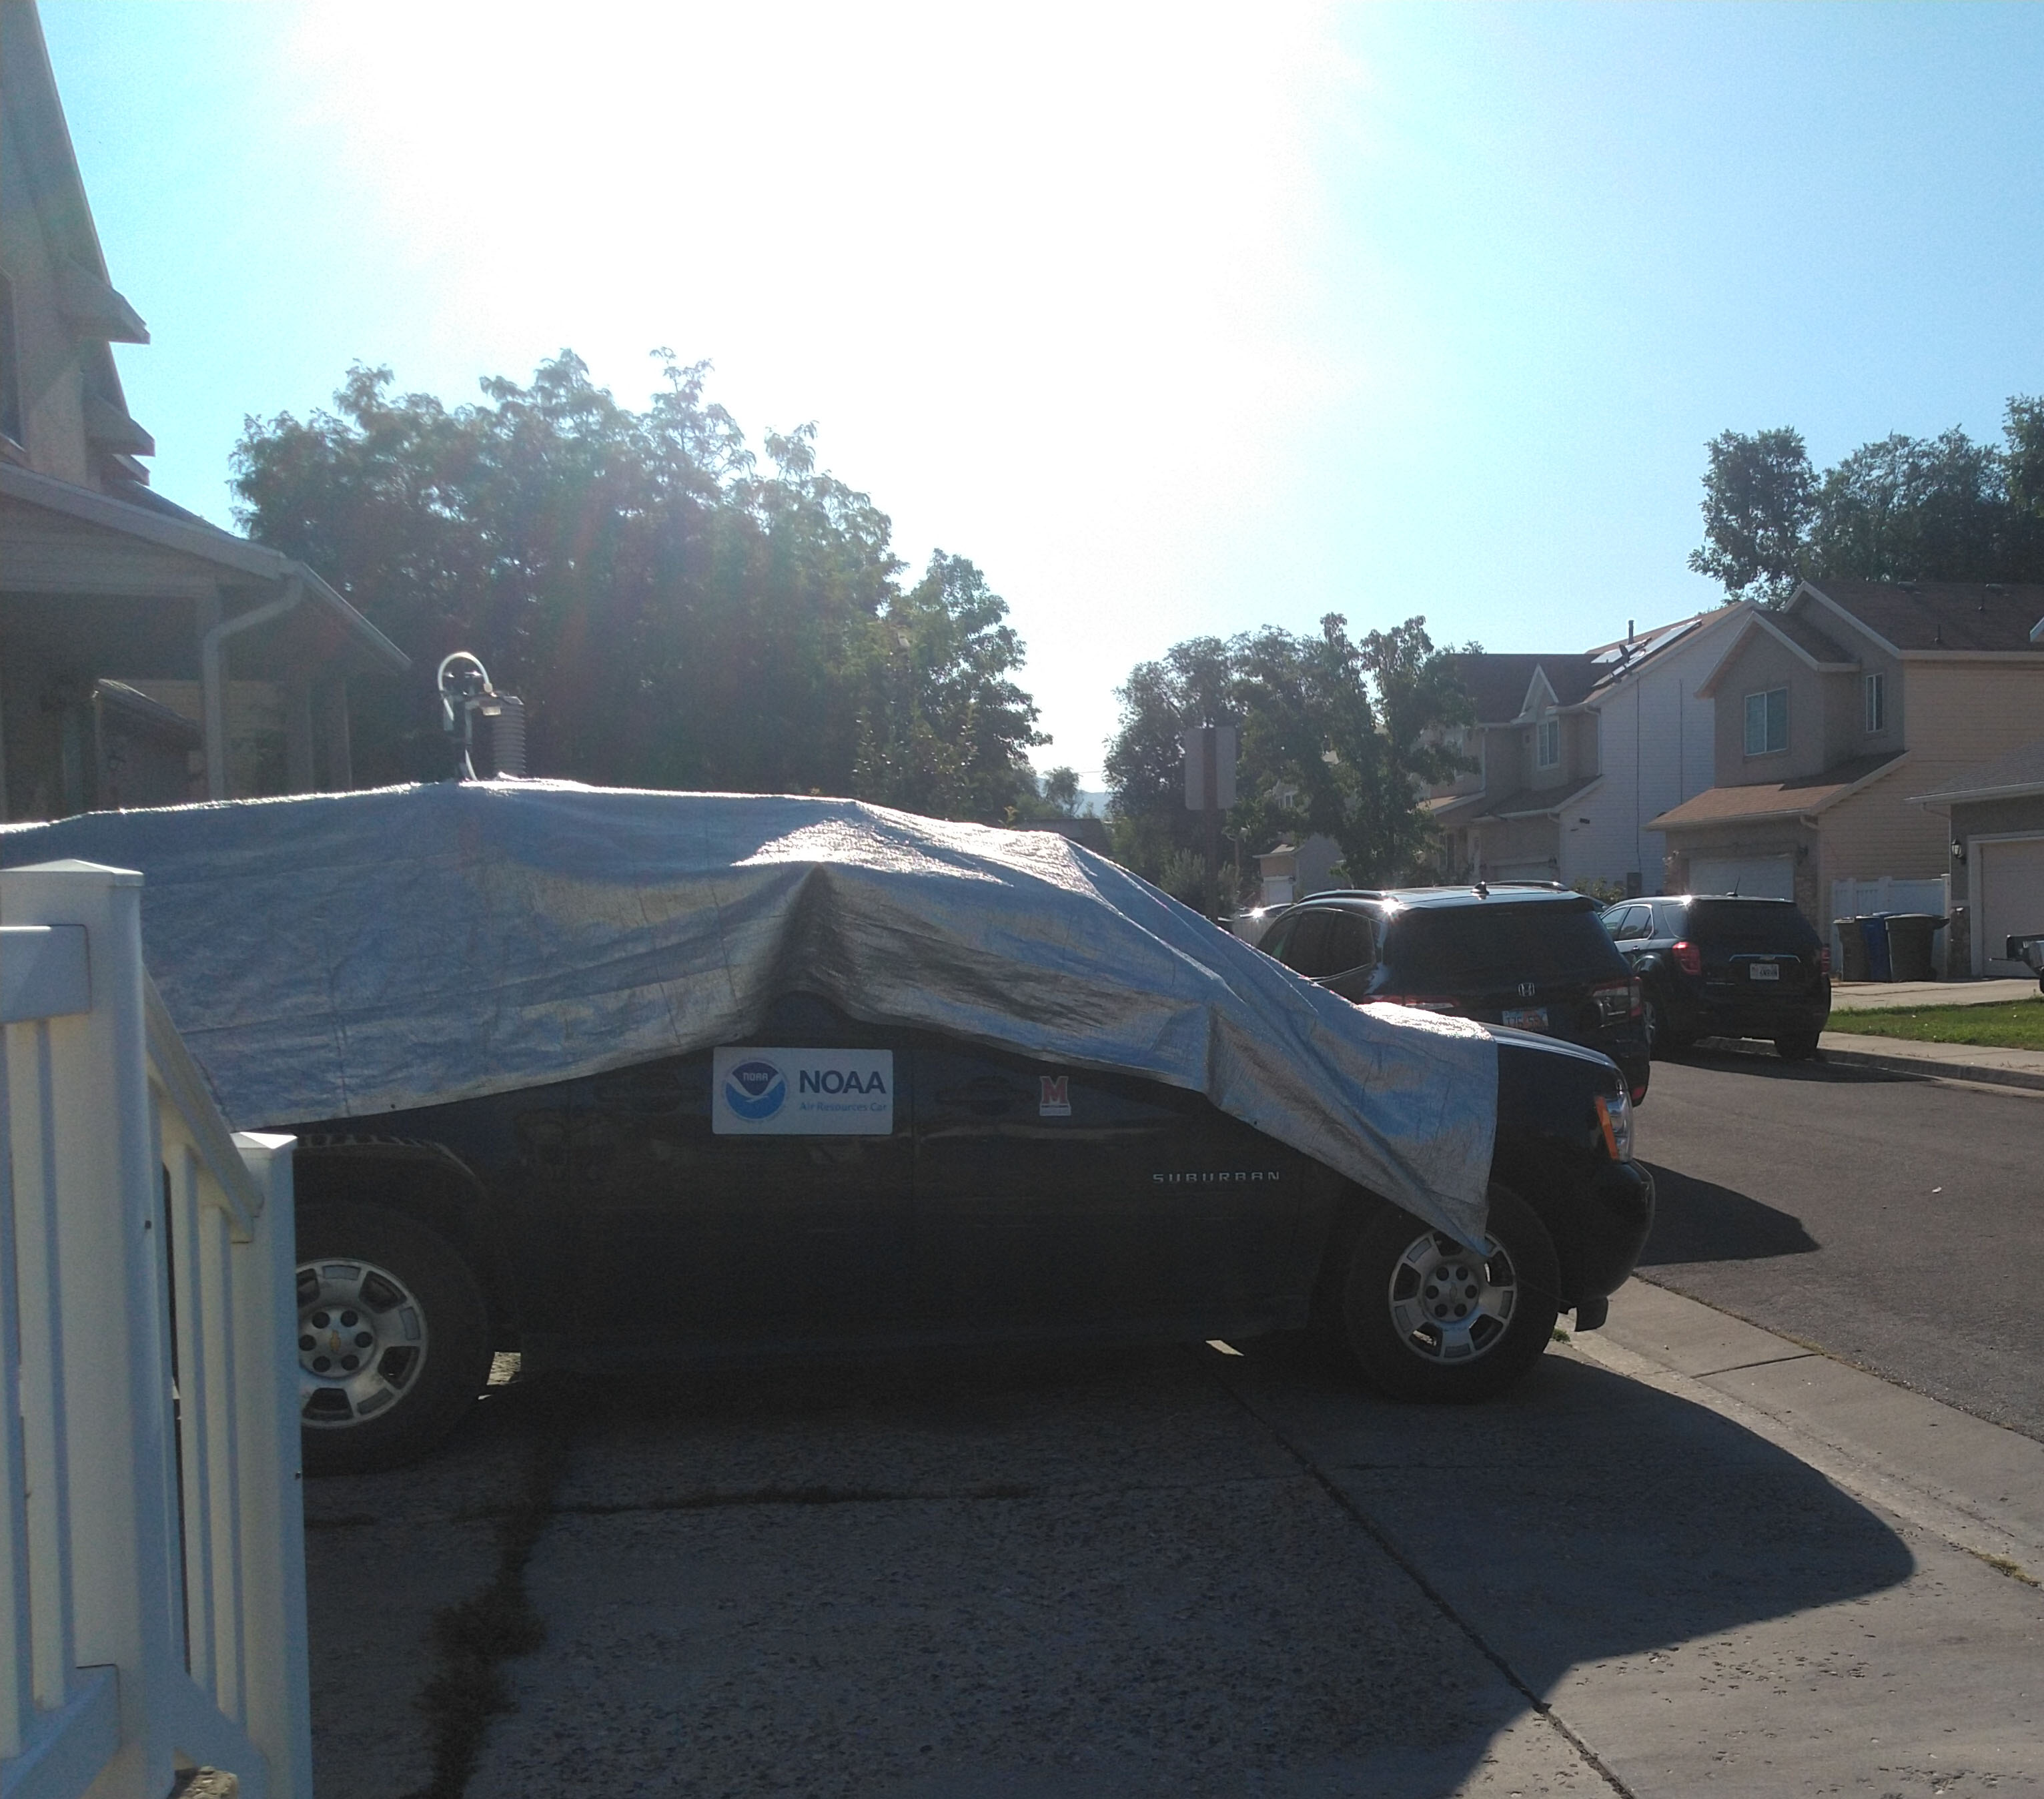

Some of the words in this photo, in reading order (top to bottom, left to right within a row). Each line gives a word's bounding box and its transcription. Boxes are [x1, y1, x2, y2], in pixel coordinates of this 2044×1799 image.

[800, 1070, 887, 1094] NOAA
[1039, 1075, 1069, 1105] M
[870, 1102, 887, 1111] Car
[1152, 1171, 1280, 1182] SUBURBAN
